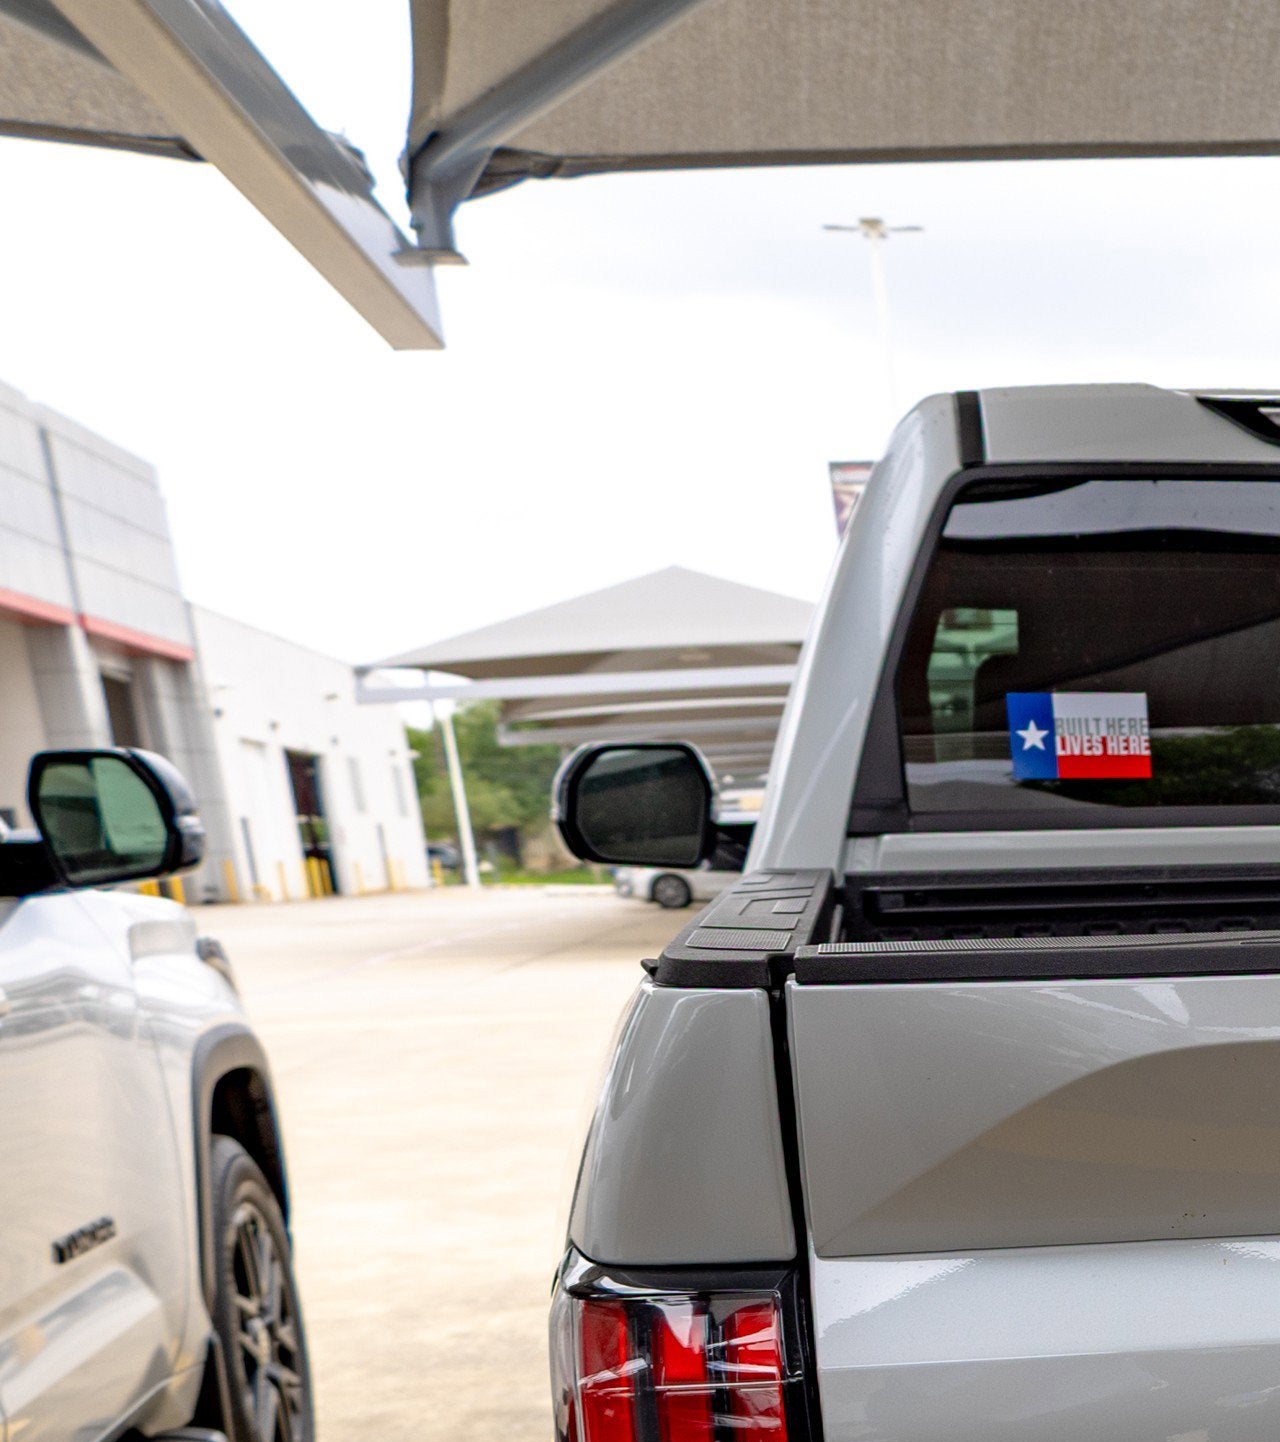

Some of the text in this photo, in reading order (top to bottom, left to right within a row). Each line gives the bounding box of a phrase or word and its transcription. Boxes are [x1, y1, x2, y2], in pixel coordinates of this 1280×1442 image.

[1056, 716, 1149, 736] BUILT HERE
[1056, 735, 1151, 756] LIVES HERE
